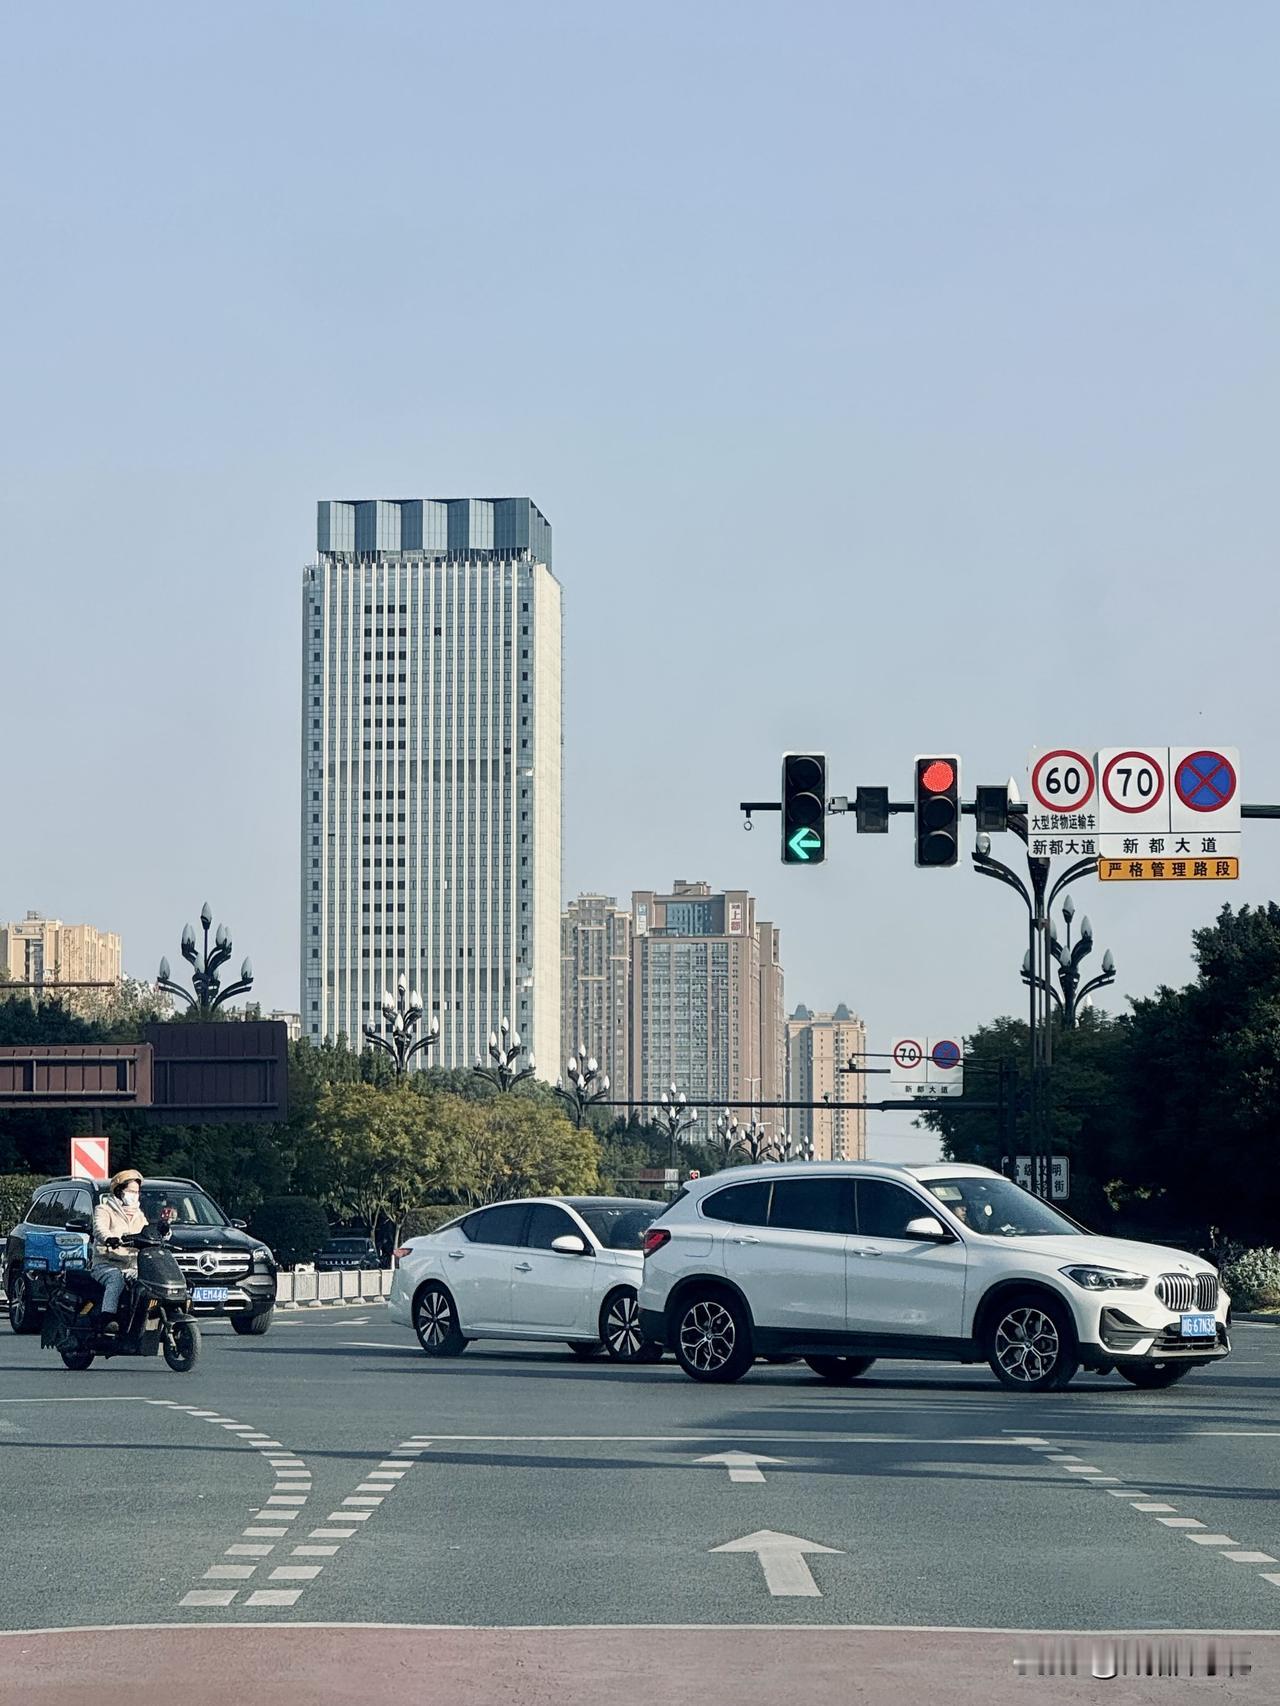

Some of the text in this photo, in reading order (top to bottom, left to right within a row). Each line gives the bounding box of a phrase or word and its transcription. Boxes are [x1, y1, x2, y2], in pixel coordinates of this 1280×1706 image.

[1046, 767, 1080, 795] 60
[1116, 768, 1153, 797] 70
[1032, 814, 1096, 830] 大型货物运输车
[1033, 839, 1096, 855] 新都大道
[1123, 837, 1218, 853] 新都大道
[1108, 861, 1231, 878] 严格管理路段
[899, 1048, 916, 1062] 70
[905, 1085, 948, 1094] 新都大道
